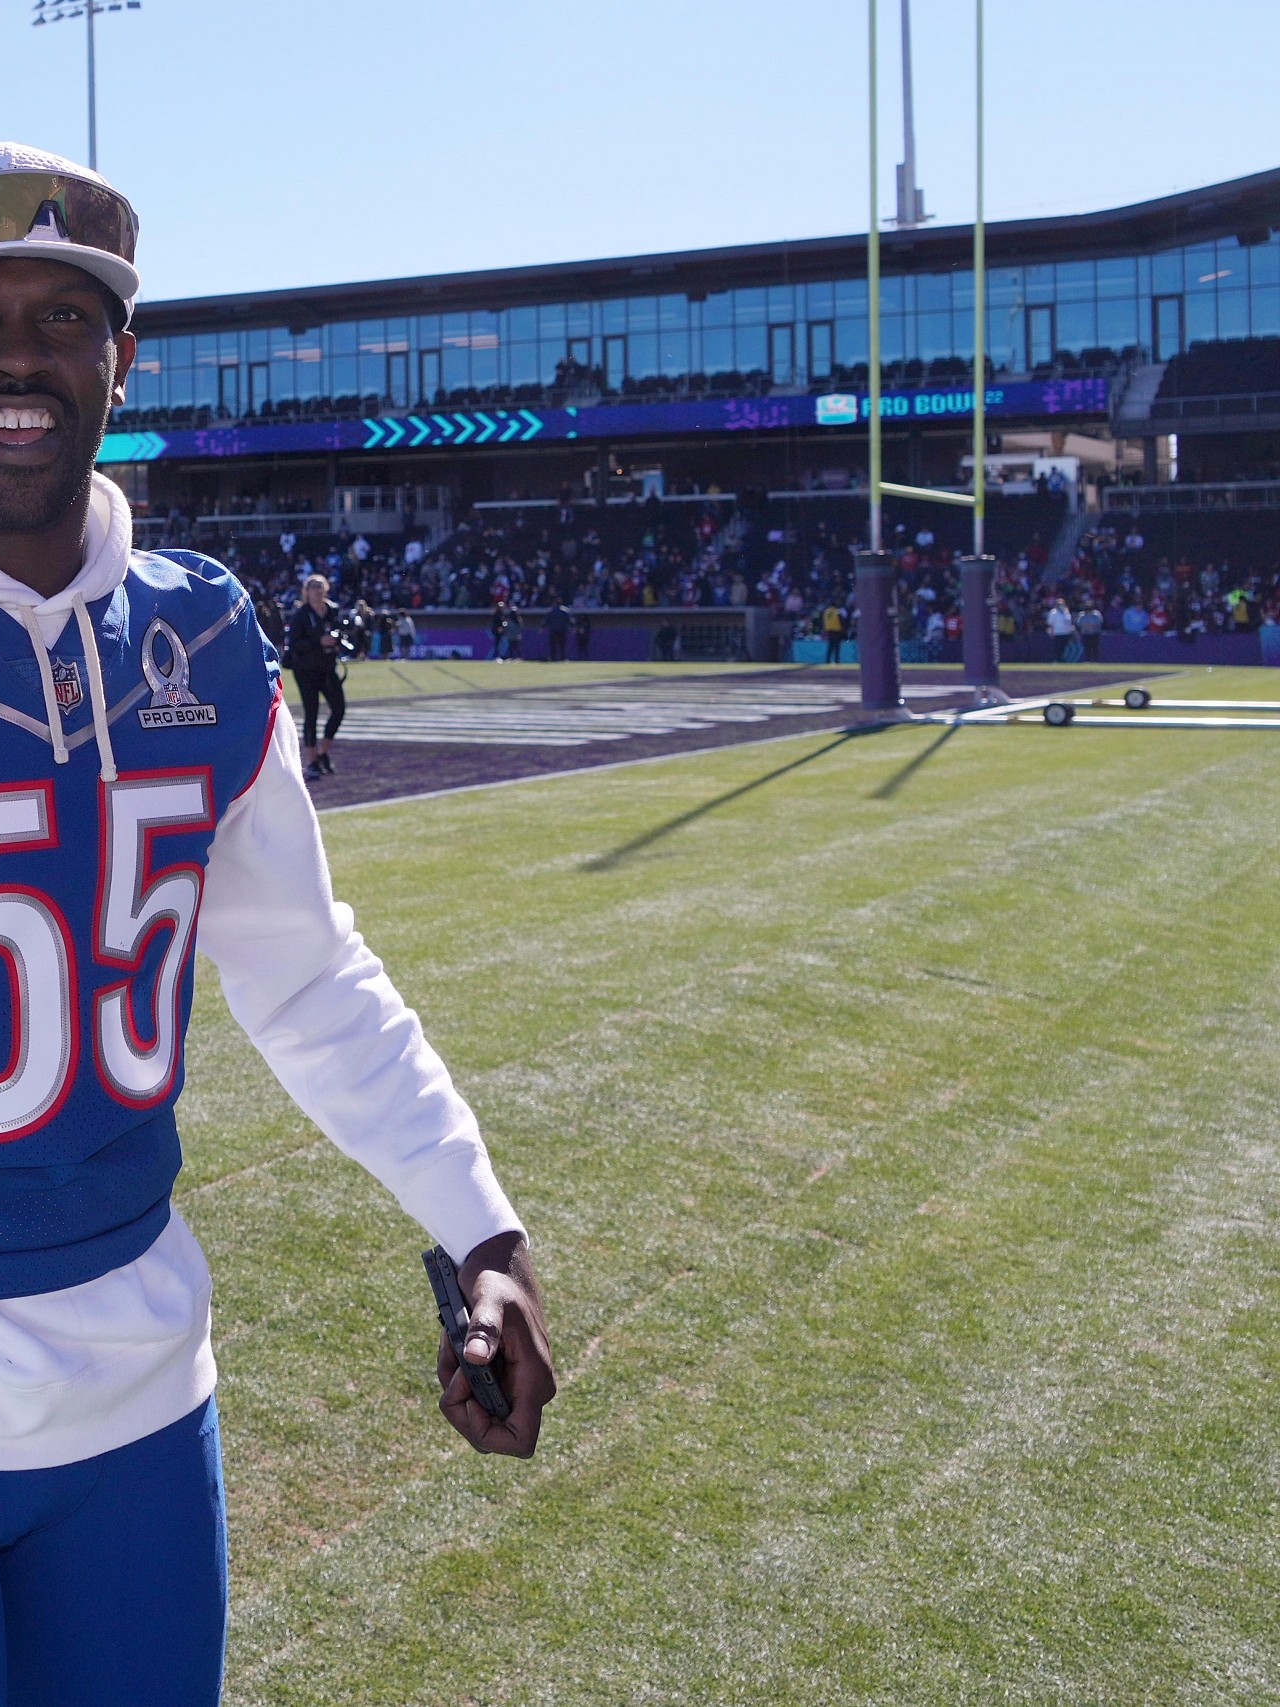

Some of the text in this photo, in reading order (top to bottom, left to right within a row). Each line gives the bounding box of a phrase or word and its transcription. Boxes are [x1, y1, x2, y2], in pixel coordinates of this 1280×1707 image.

[861, 395, 909, 417] PRO
[54, 683, 78, 704] NFL
[166, 692, 181, 704] NFL
[143, 709, 216, 725] PRO BOWL
